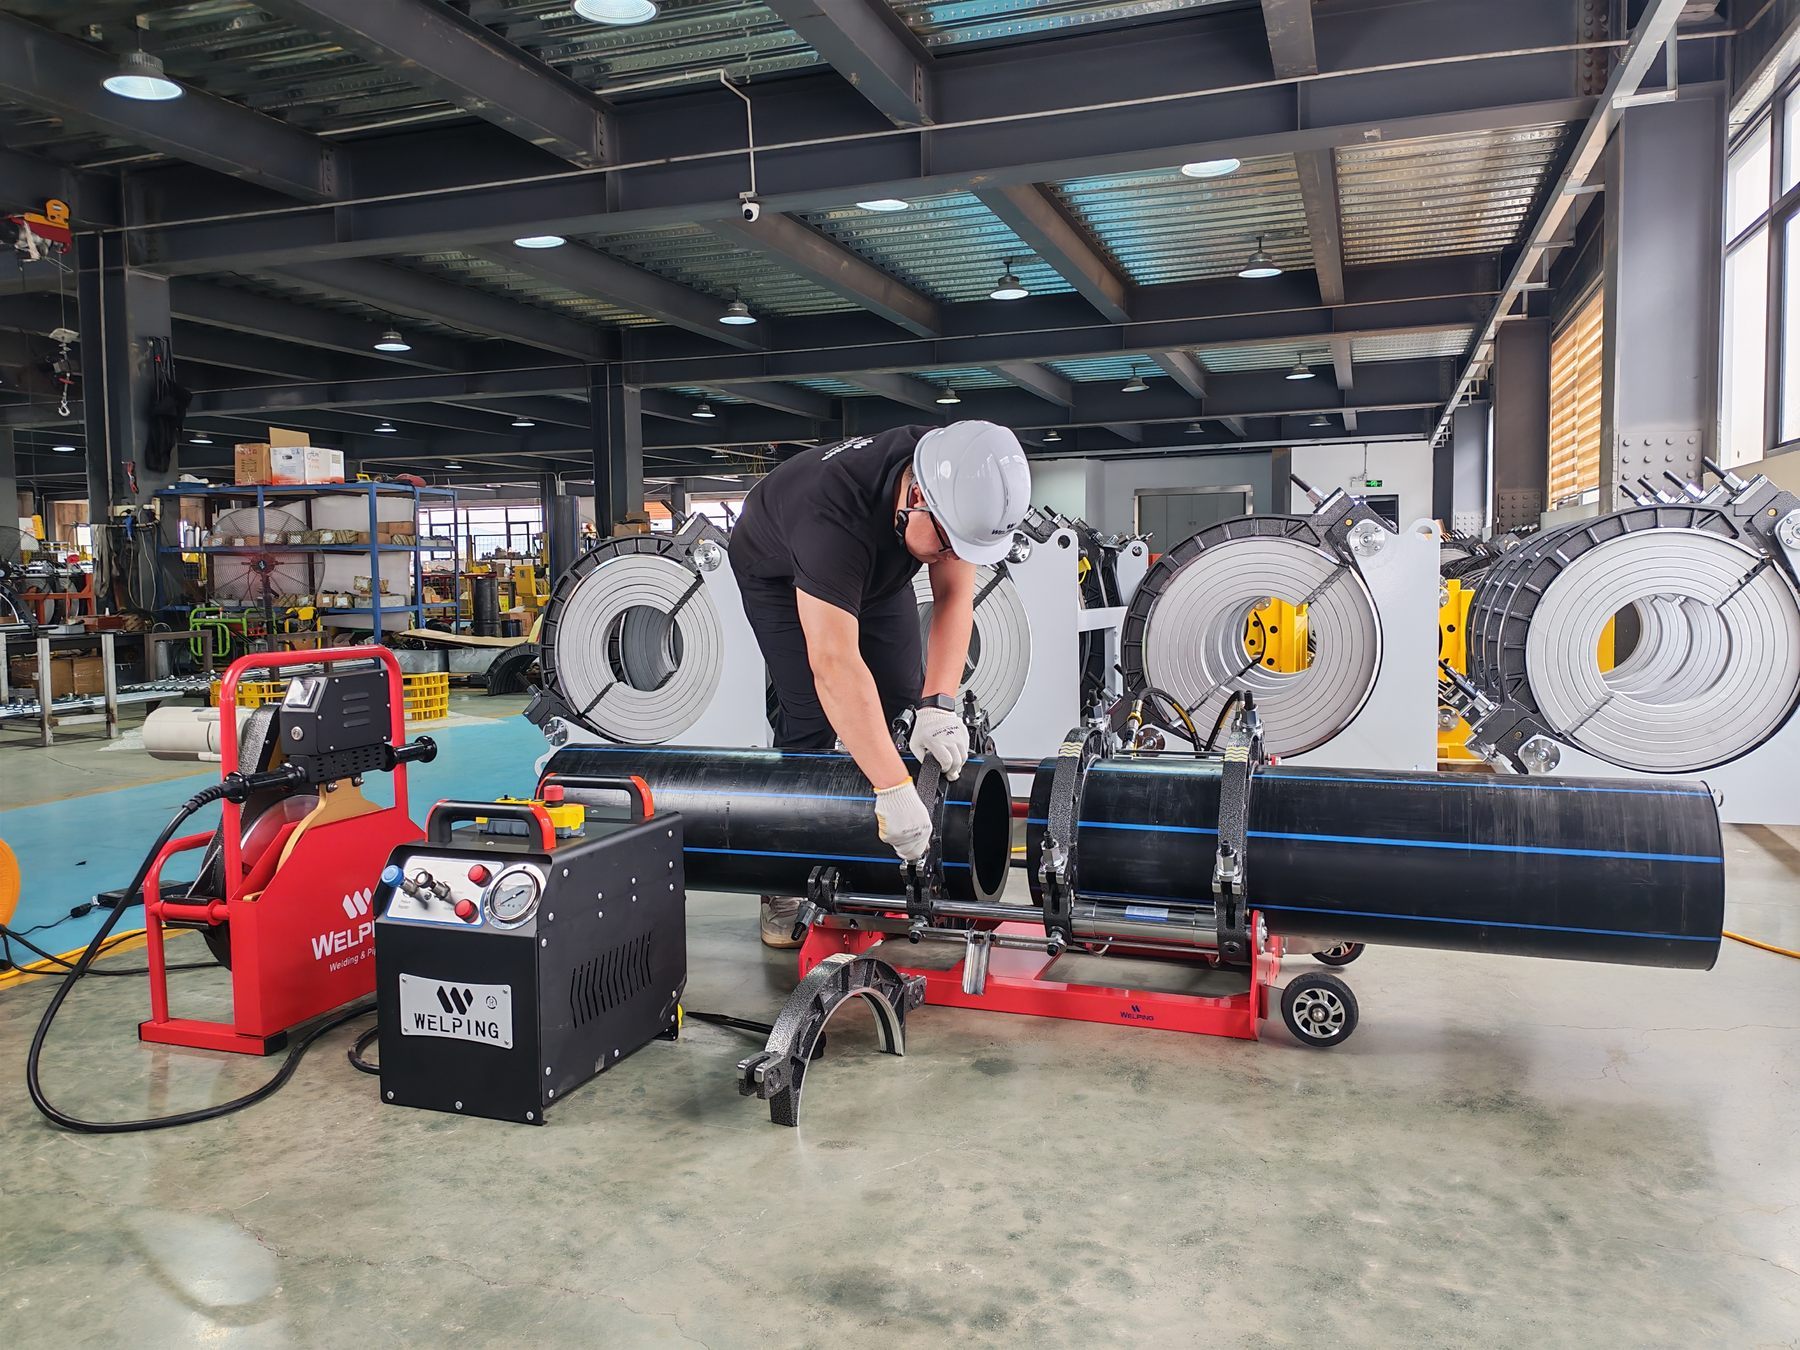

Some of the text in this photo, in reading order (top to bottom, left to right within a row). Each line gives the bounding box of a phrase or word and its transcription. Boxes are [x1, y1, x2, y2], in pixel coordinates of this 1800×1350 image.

[329, 955, 359, 972] Welding
[360, 950, 366, 960] &
[414, 1013, 499, 1039] WELPING
[1120, 1011, 1154, 1021] WELPING
